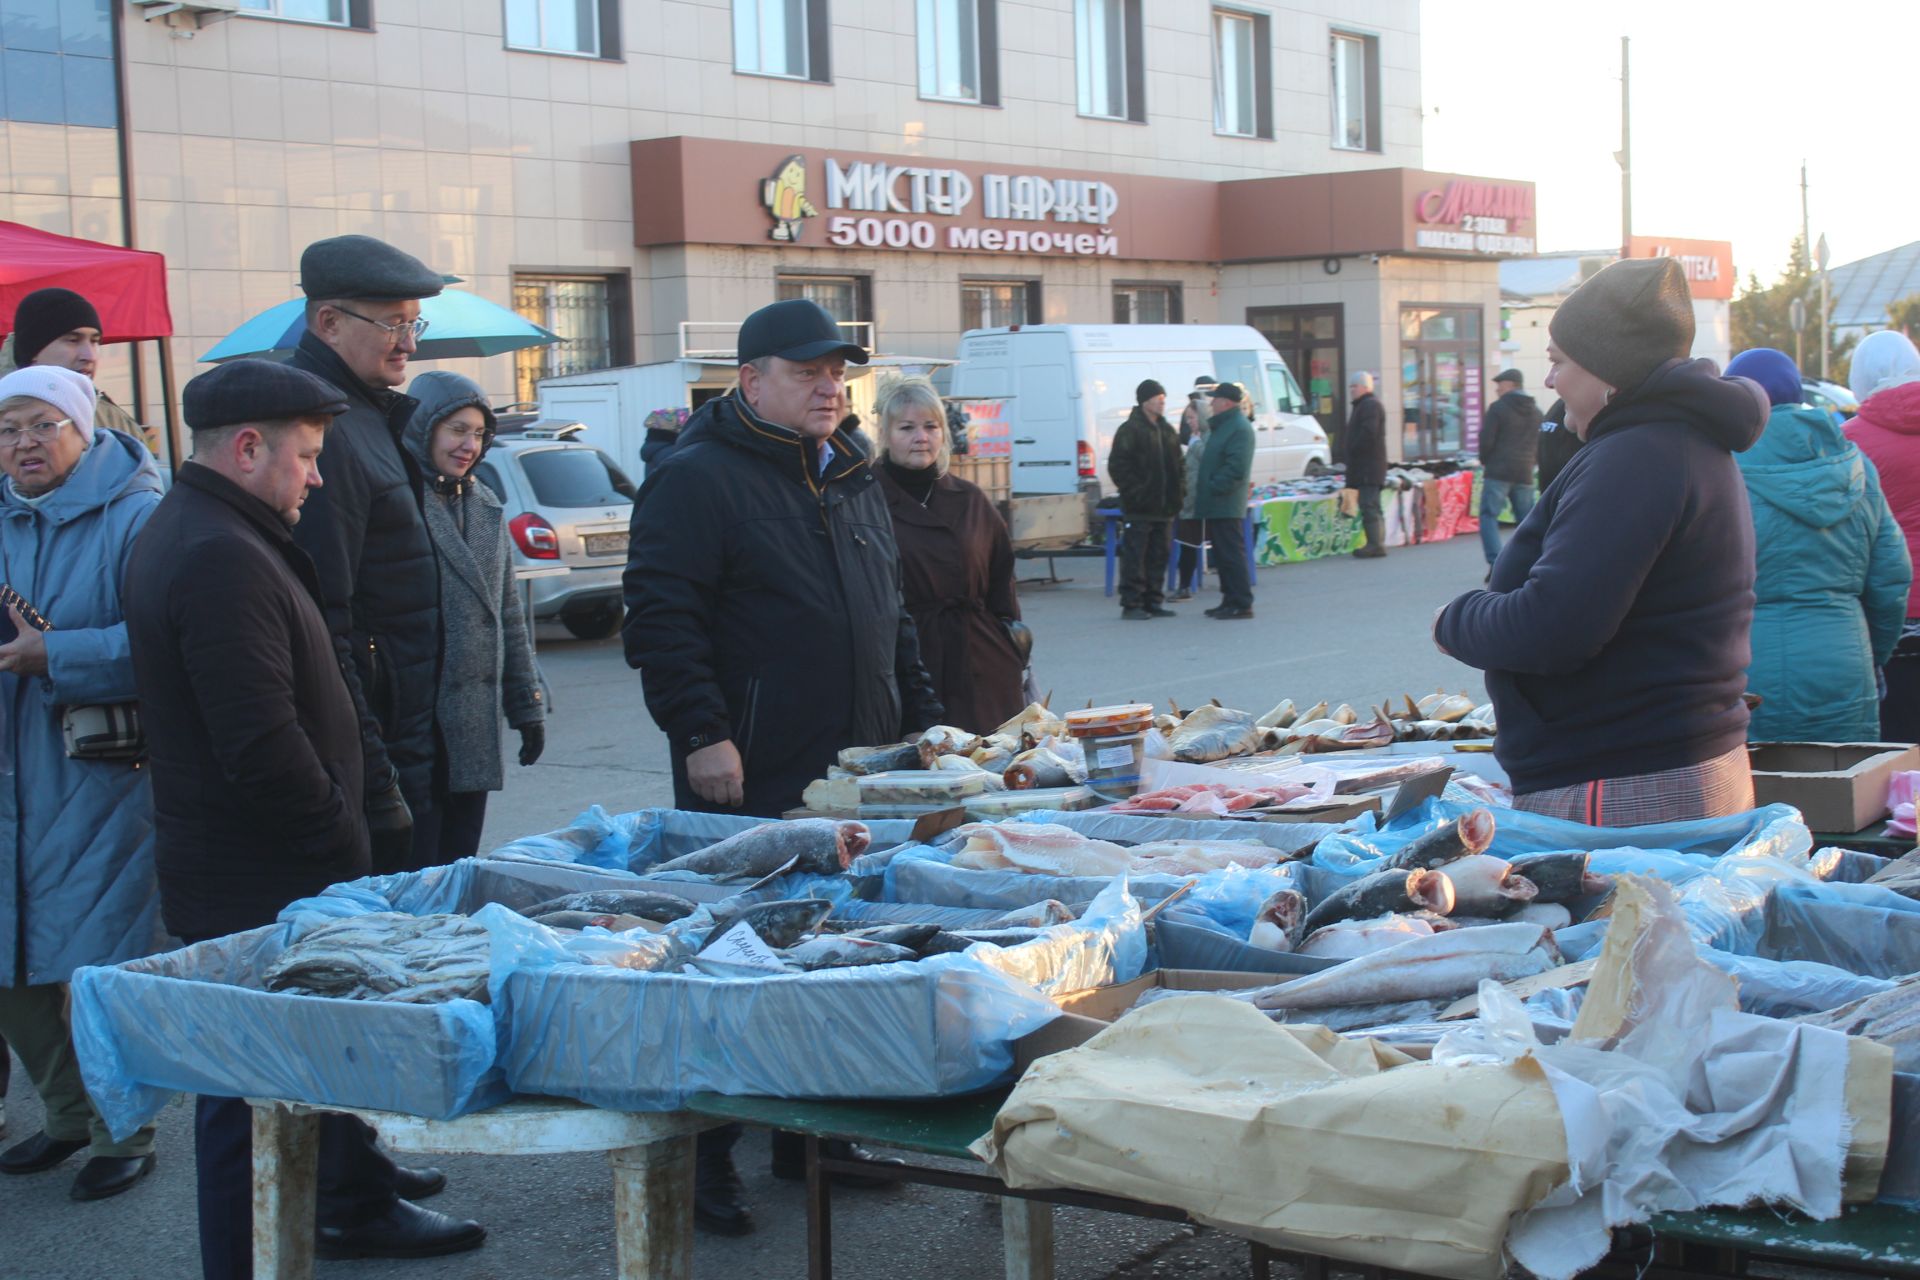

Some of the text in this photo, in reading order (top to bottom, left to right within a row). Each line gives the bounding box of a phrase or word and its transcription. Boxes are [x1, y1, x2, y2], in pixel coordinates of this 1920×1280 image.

[825, 158, 1118, 225] МИСТЕР ПАРКЕР
[828, 216, 1118, 256] 5000 мелочей
[1462, 214, 1474, 232] 2
